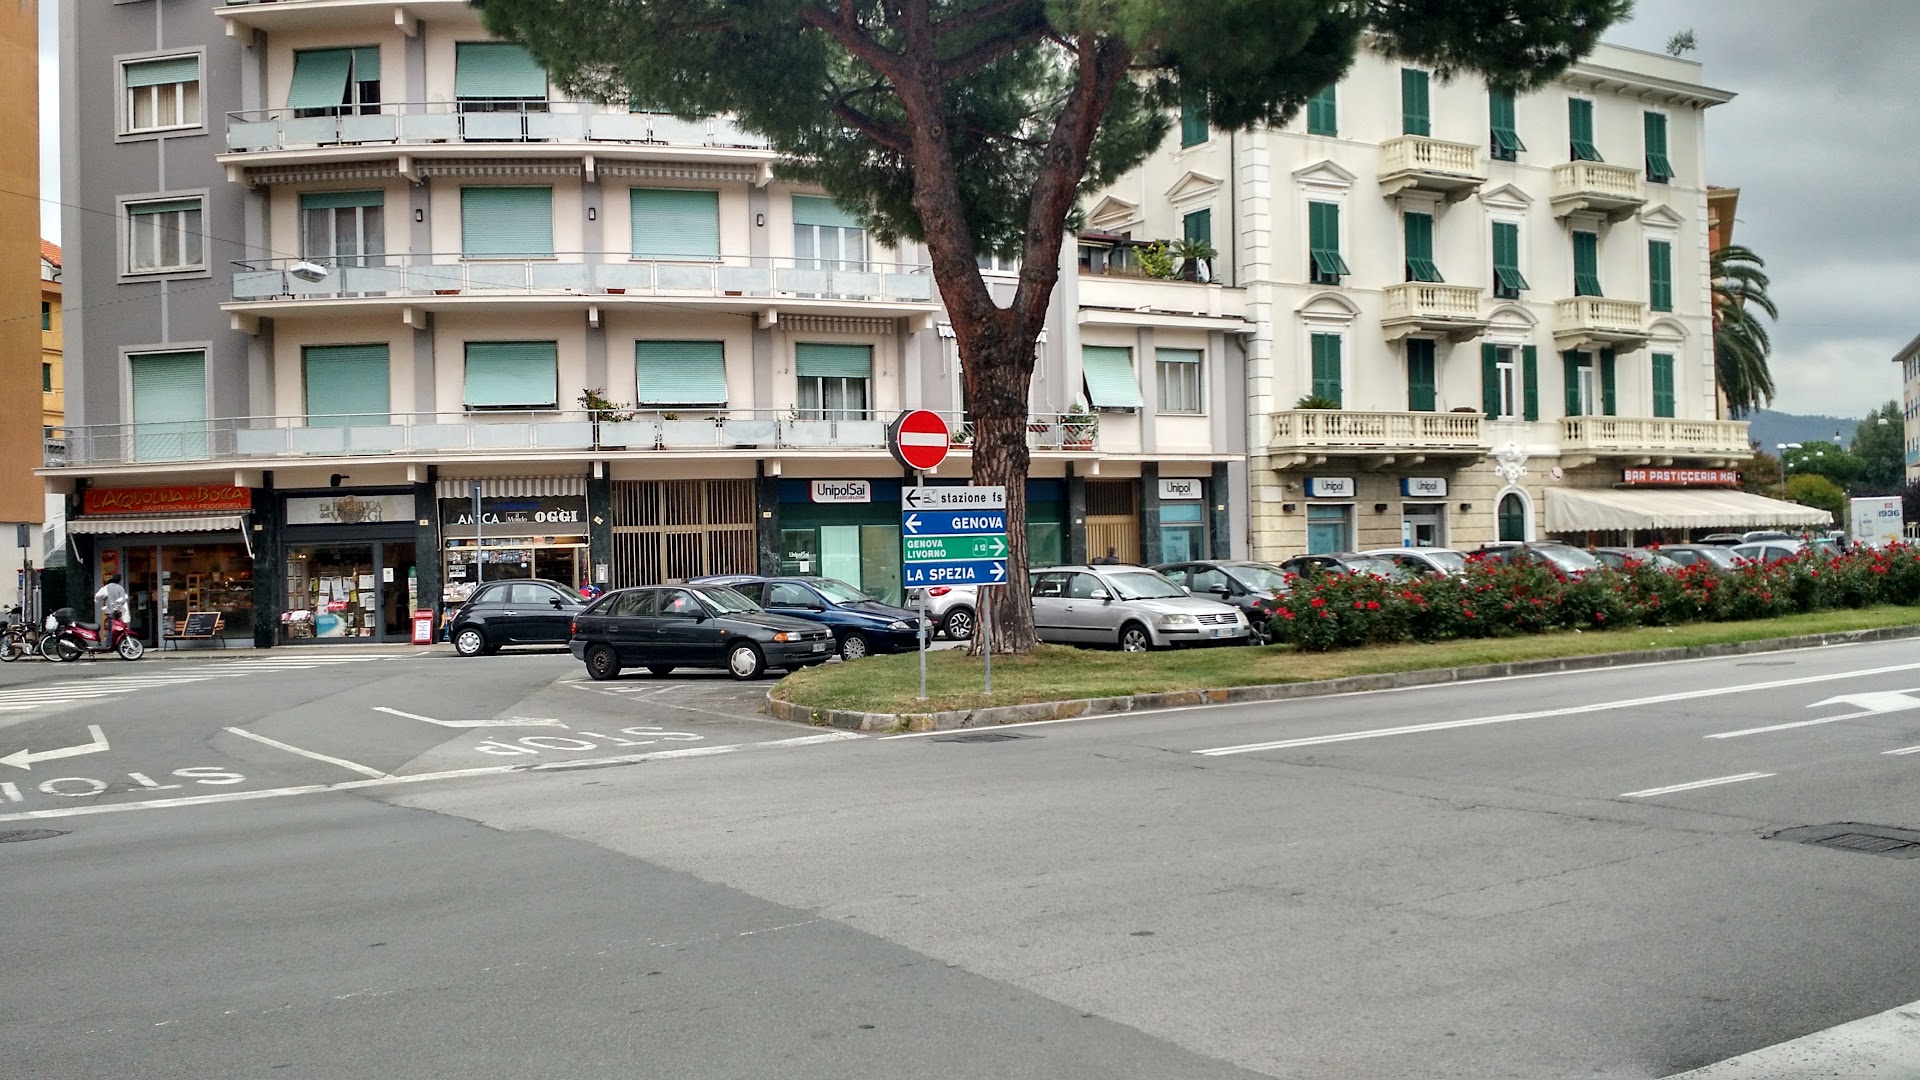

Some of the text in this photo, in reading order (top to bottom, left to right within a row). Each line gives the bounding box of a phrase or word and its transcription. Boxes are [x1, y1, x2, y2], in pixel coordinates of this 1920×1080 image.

[1624, 470, 1646, 480] BAR
[1649, 470, 1717, 481] PASTICCERIA
[817, 483, 865, 500] UnipolSai
[1167, 482, 1190, 494] Unipol
[1321, 480, 1344, 492] Unipol
[1417, 480, 1437, 492] Unipol
[941, 492, 1002, 503] stazione fs
[320, 504, 330, 512] La
[458, 513, 500, 524] AMCA
[952, 516, 1003, 529] GENOVA
[908, 540, 943, 548] GENOVA
[974, 544, 978, 552] A
[908, 550, 946, 558] LIVORNO
[906, 567, 975, 581] LA SPEZIA
[474, 726, 705, 756] STOP
